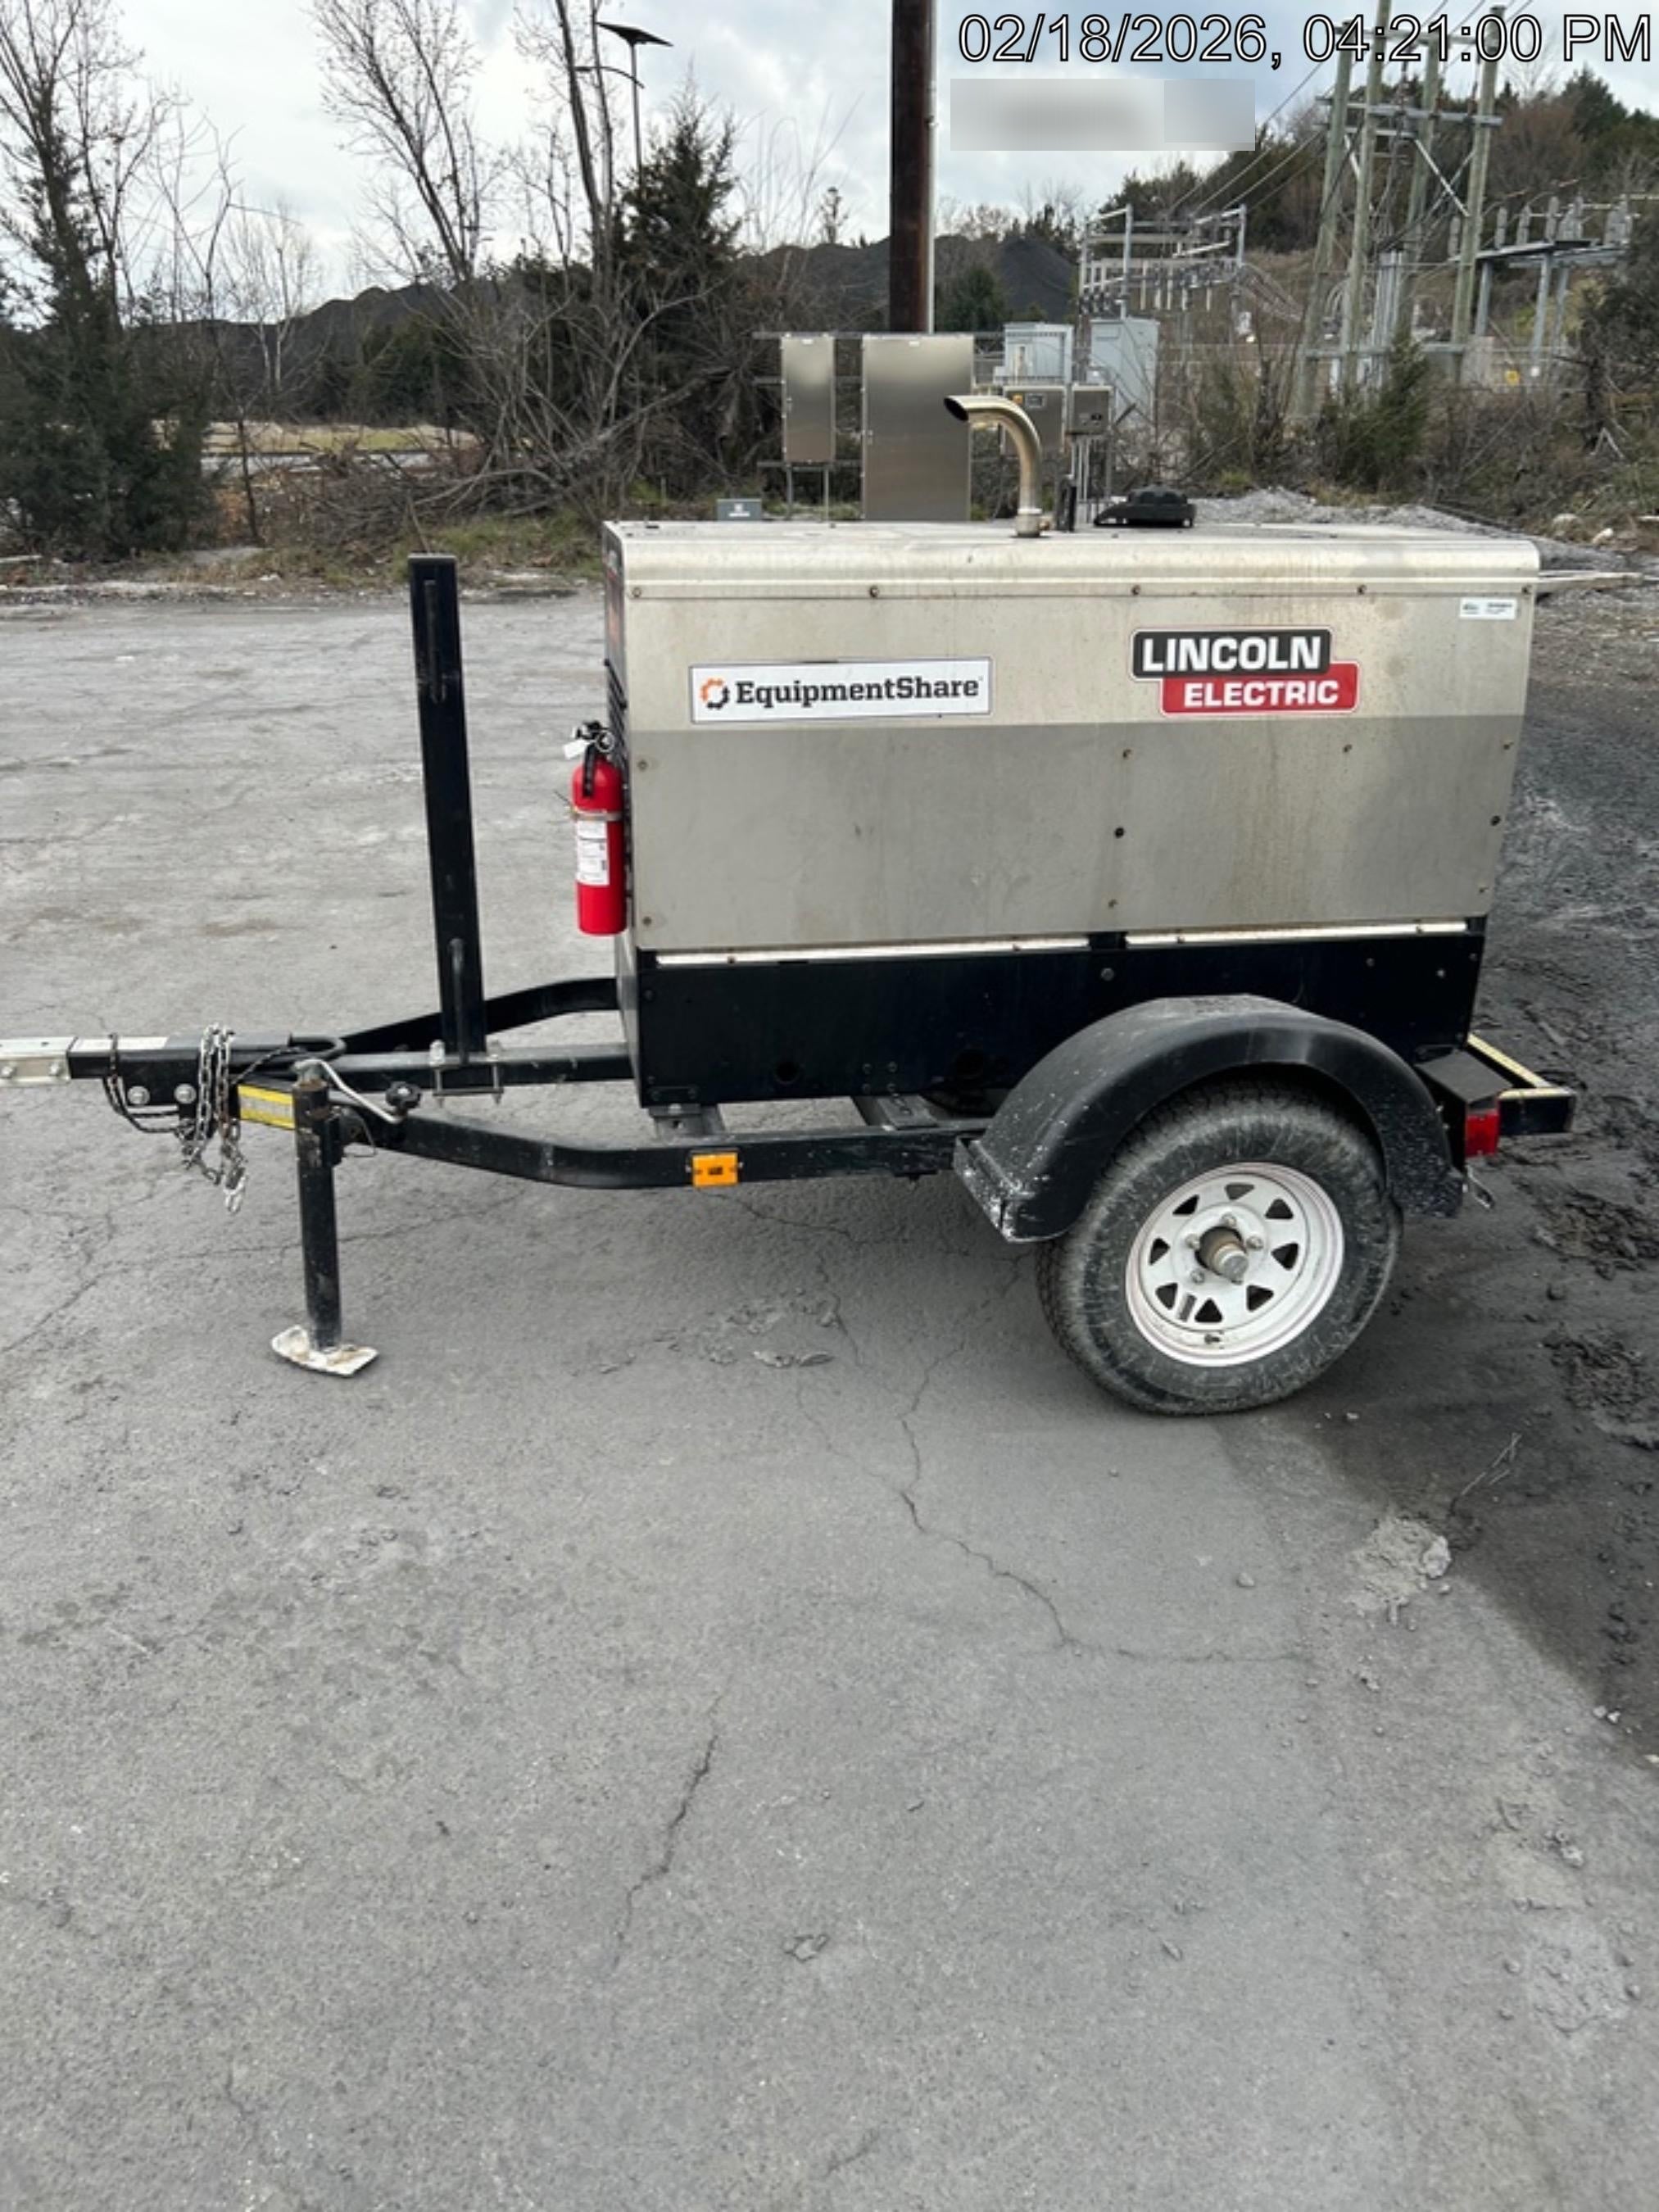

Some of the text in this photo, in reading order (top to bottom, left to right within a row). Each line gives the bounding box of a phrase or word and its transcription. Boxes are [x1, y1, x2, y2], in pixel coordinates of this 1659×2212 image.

[1143, 637, 1321, 672] LINCOLN
[736, 676, 979, 709] EquipmentShare
[1184, 680, 1339, 708] ELECTRIC
